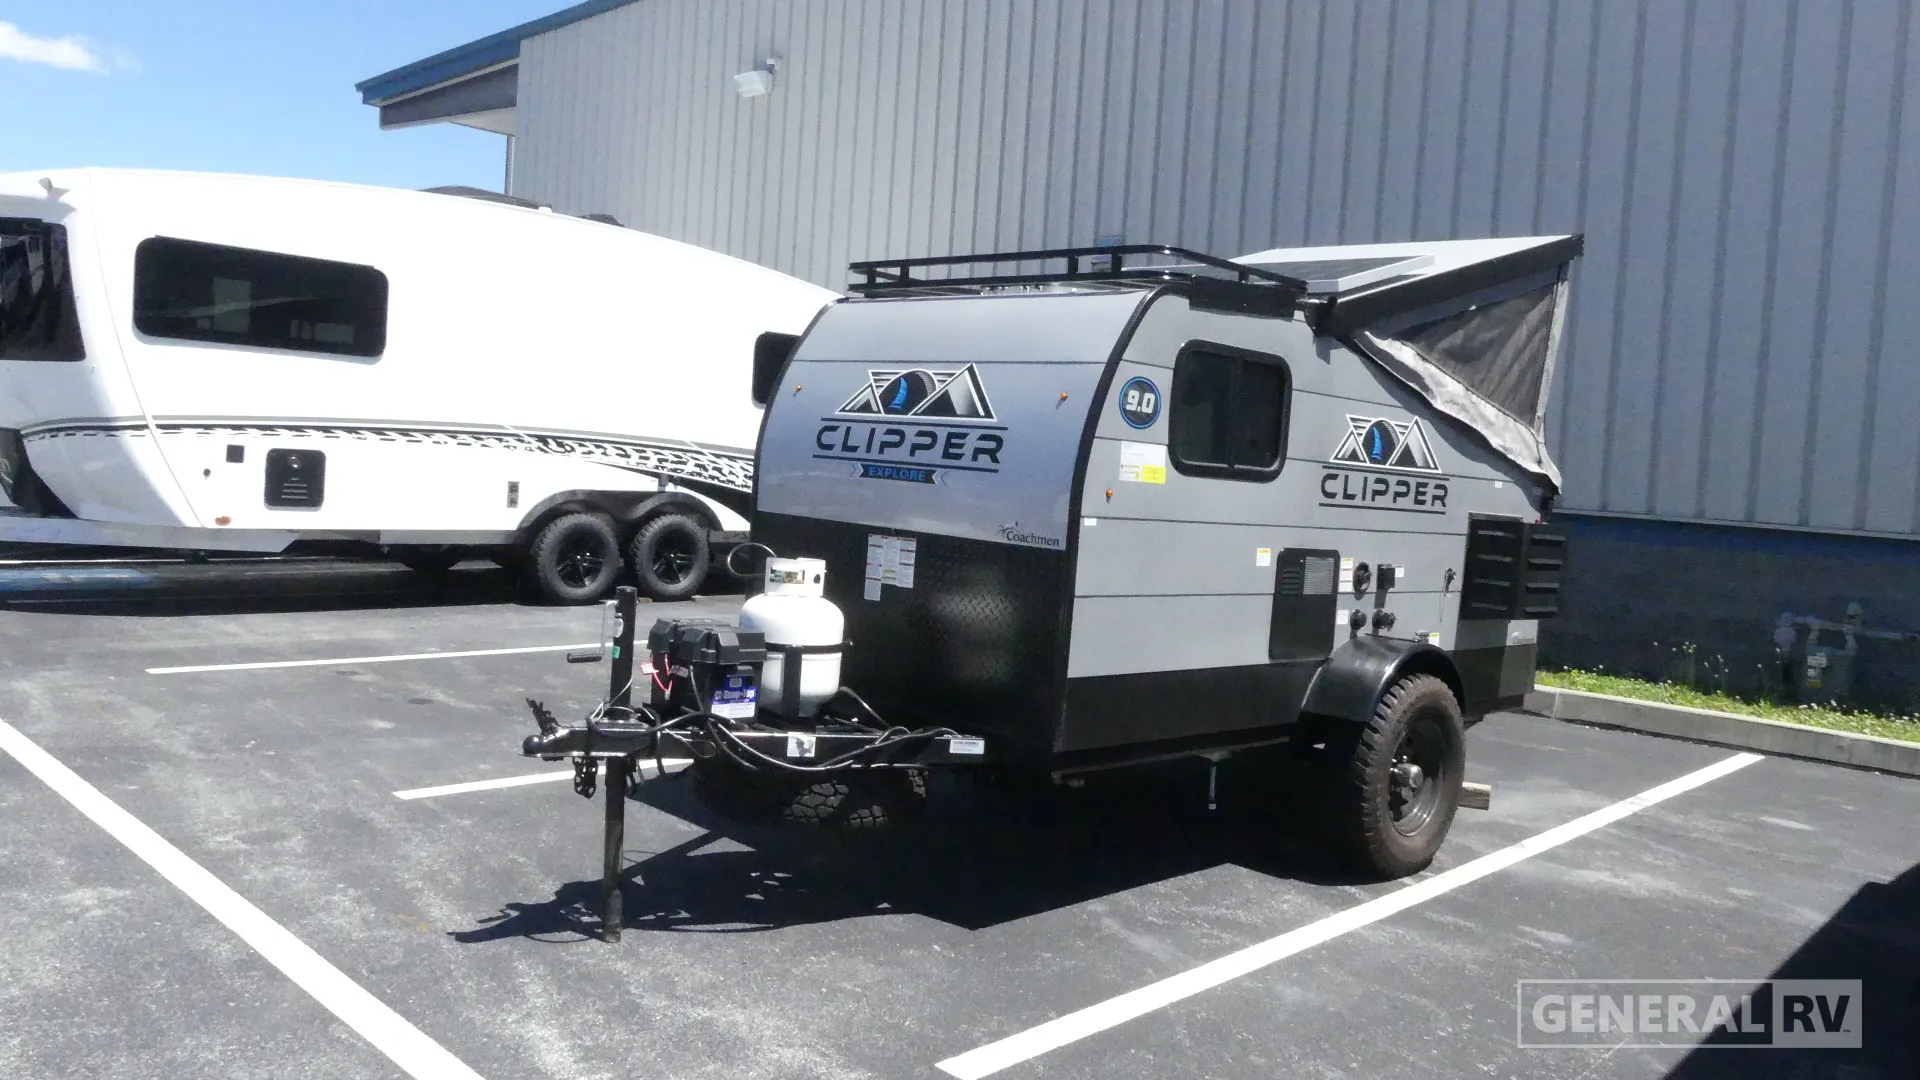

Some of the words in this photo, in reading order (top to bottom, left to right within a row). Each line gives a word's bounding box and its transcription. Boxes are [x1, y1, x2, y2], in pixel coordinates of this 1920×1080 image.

[1125, 389, 1156, 414] 9.0
[816, 425, 1005, 464] CLIPPER
[868, 464, 927, 481] EXPLORE
[1320, 473, 1449, 508] CLIPPER
[1006, 530, 1060, 547] Coachmen
